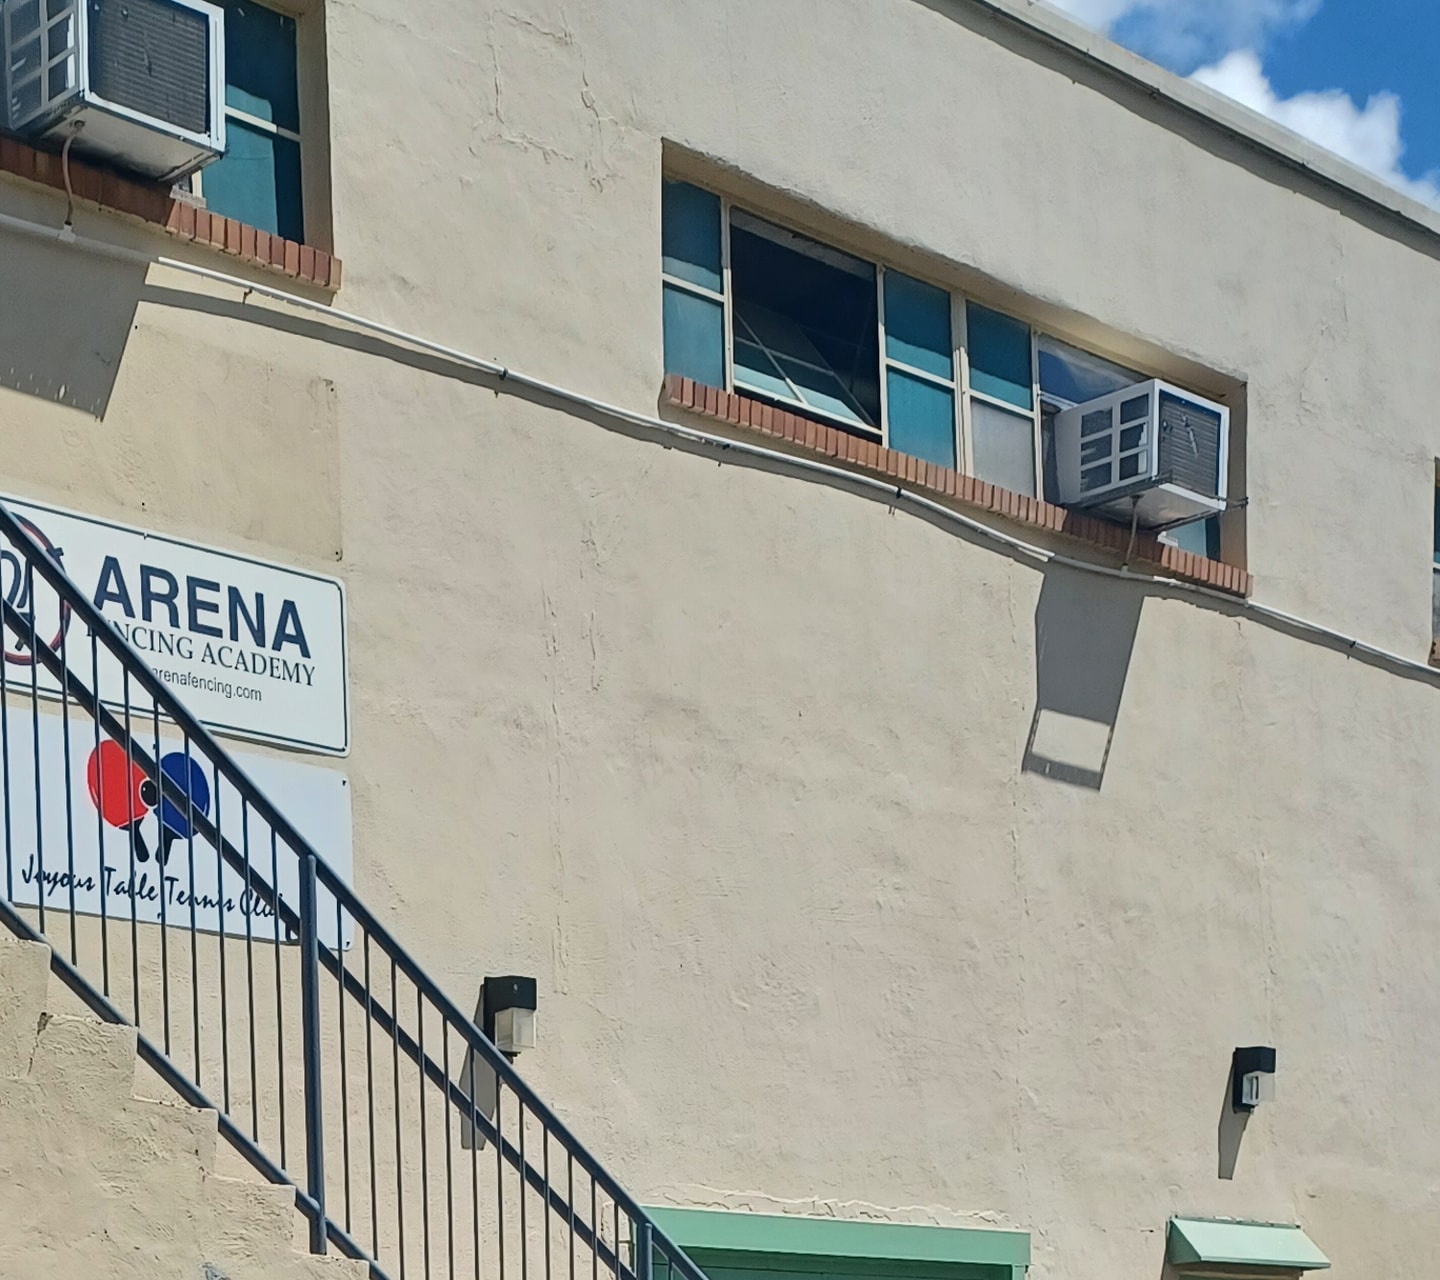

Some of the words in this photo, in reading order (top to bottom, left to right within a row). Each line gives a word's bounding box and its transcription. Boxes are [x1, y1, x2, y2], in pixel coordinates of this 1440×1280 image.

[94, 556, 311, 659] ARENA
[87, 619, 193, 660] NCING
[201, 642, 315, 686] ACADEMY
[240, 888, 285, 918] Clu
